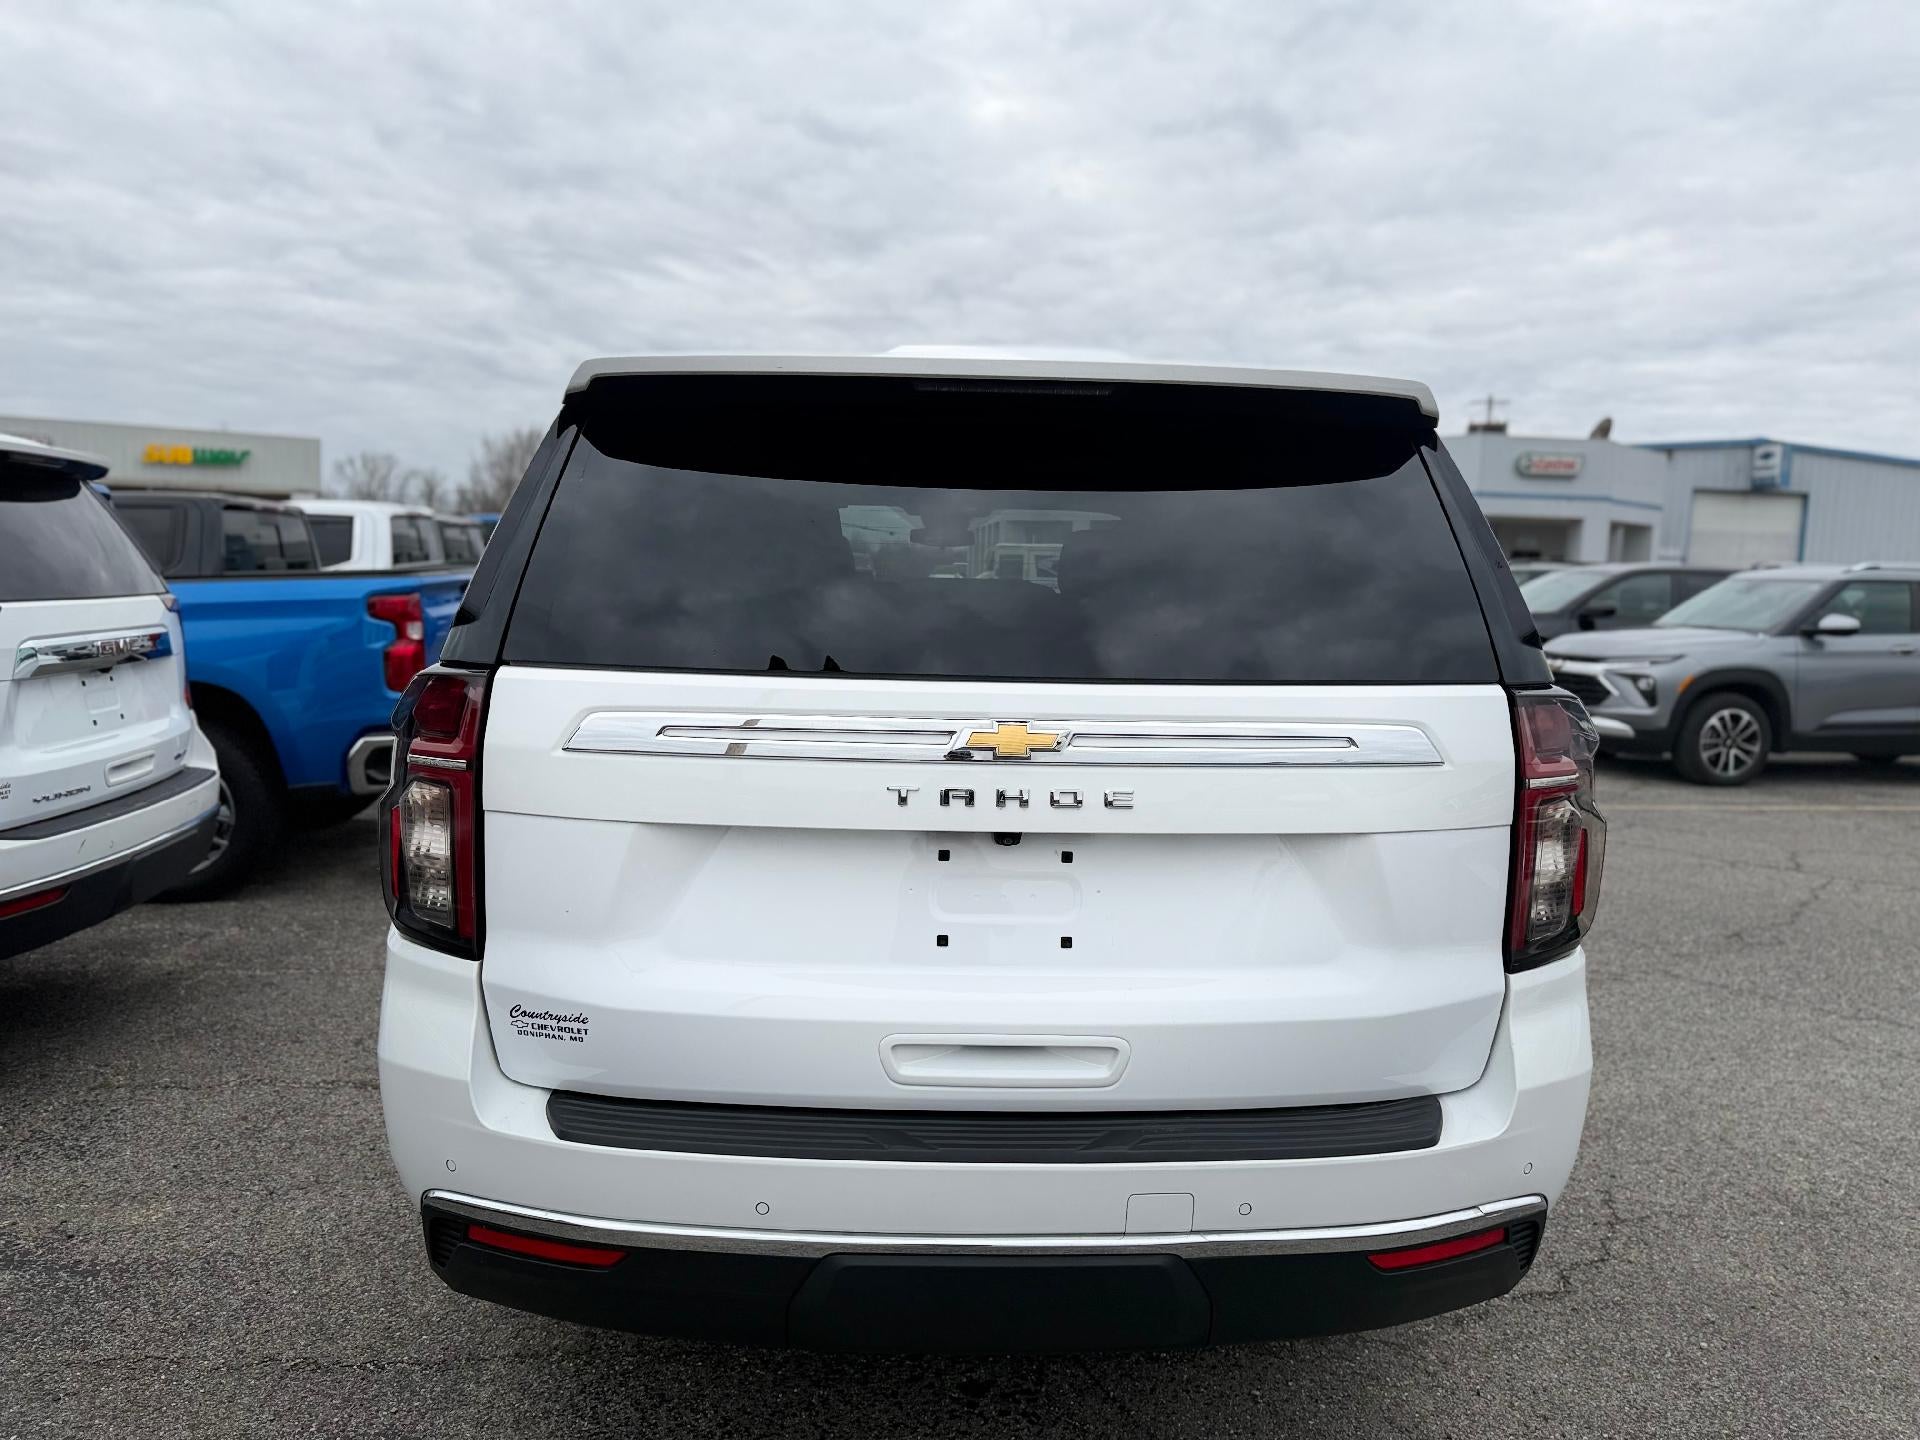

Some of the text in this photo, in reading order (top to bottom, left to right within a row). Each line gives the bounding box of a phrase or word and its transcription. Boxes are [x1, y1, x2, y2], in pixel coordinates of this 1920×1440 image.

[97, 637, 145, 657] GMC
[32, 785, 91, 803] YUKON
[886, 786, 1134, 809] TAHOE
[509, 1004, 589, 1025] Countryside
[517, 1029, 584, 1043] DONIPHAN, MO
[531, 1022, 589, 1035] CHEVROLET
